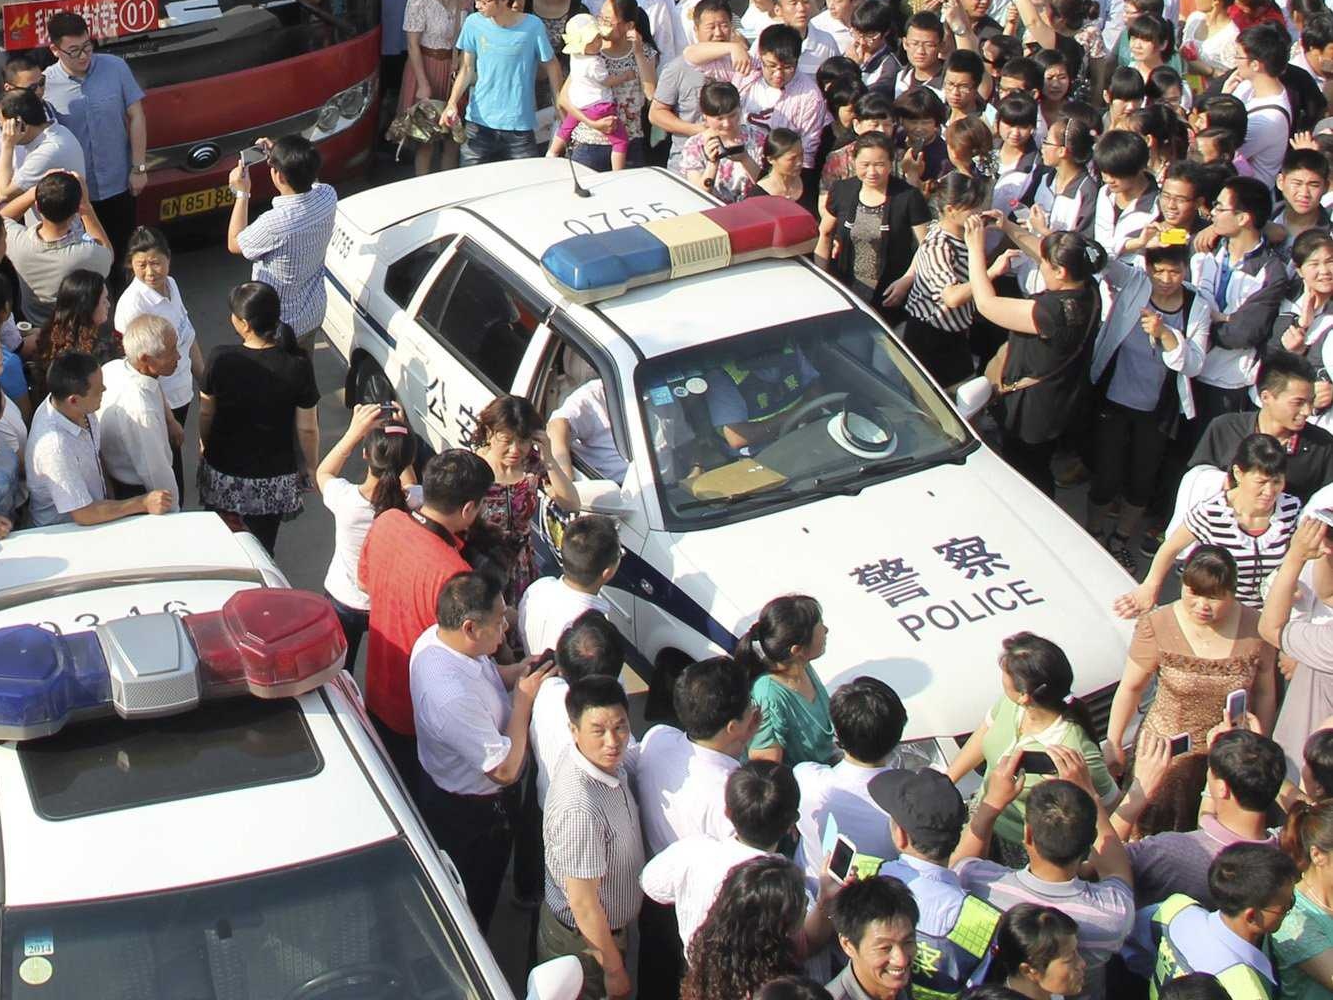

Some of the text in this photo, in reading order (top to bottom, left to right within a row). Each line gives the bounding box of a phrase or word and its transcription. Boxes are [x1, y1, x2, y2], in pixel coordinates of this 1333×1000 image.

[126, 0, 148, 27] 01
[563, 202, 679, 237] 0755
[848, 535, 1010, 608] 警察
[896, 579, 1045, 642] POLICE
